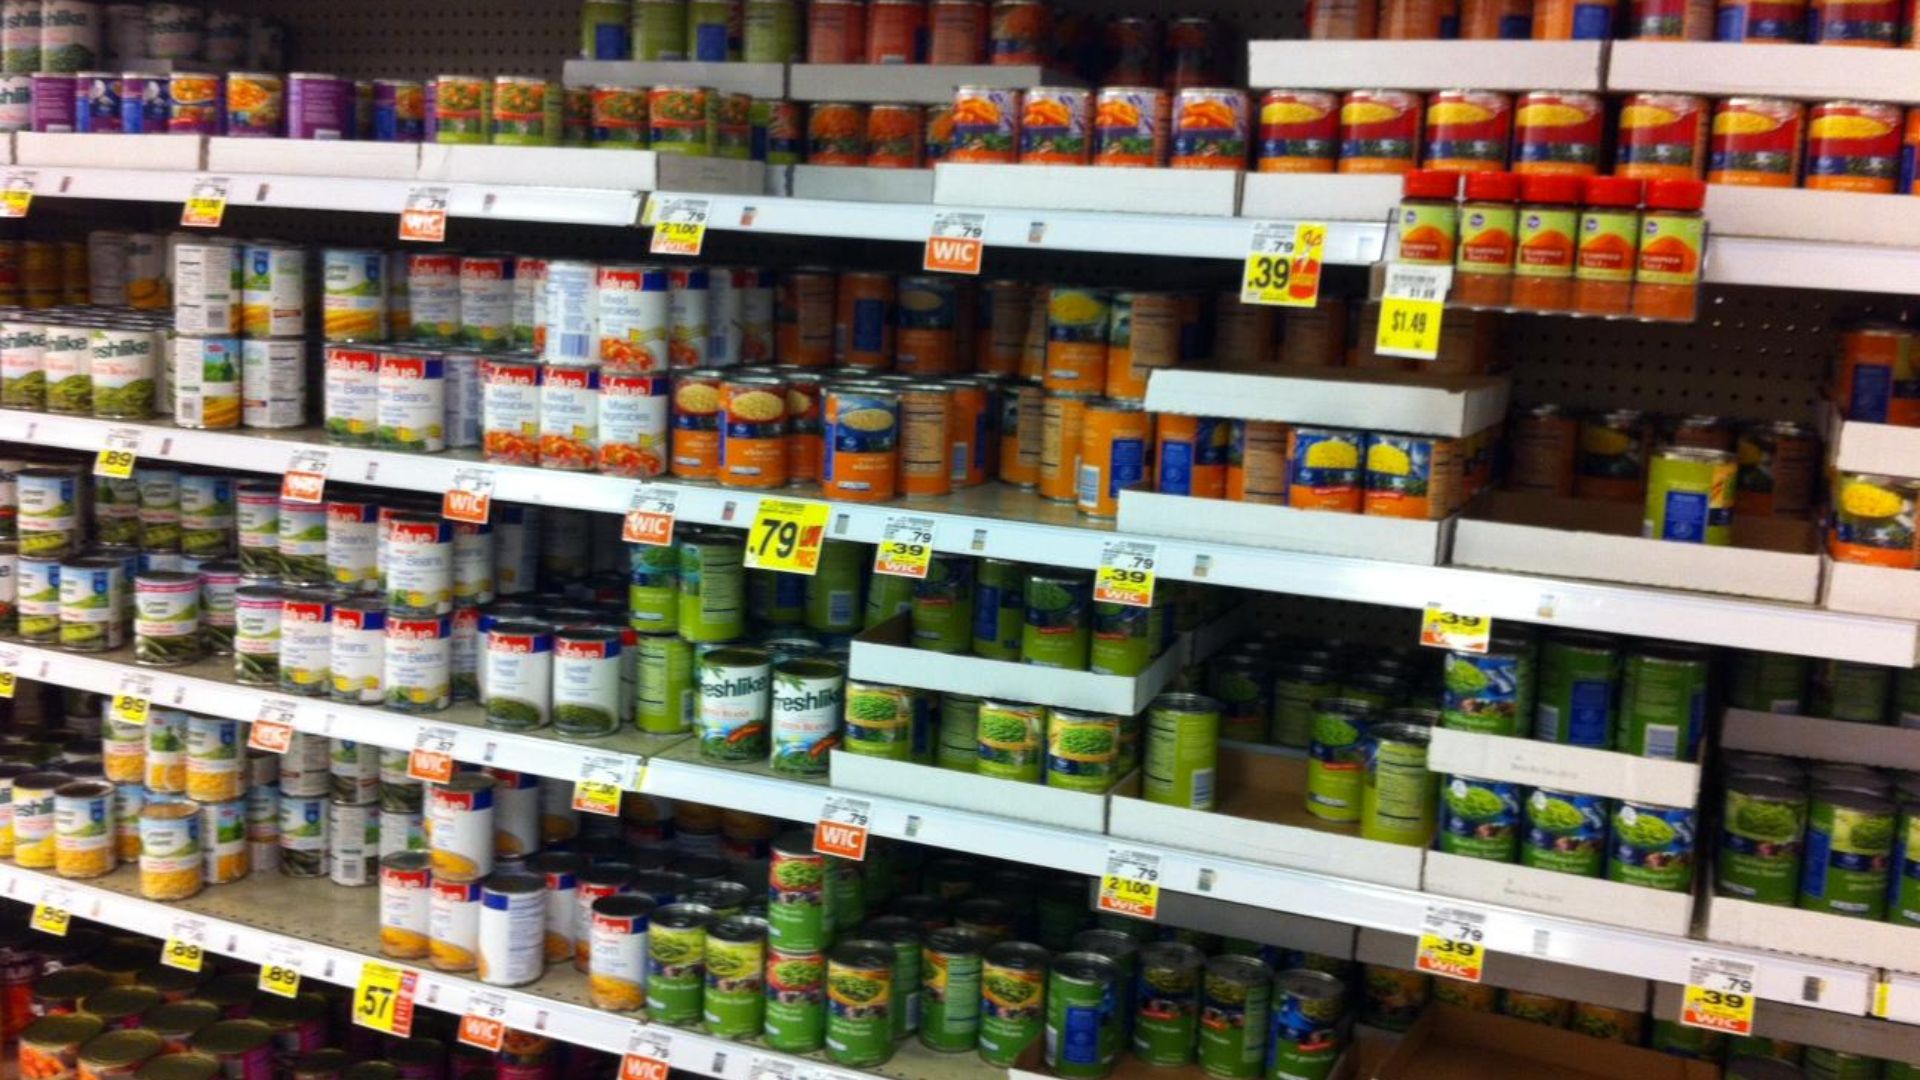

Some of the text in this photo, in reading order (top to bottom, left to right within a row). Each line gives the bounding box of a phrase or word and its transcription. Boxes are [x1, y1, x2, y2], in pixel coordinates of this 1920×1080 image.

[933, 240, 975, 262] WIC
[1247, 256, 1290, 289] .39
[1391, 310, 1428, 334] $1.49
[450, 494, 484, 513] WIC
[749, 518, 798, 559] .79
[1104, 568, 1147, 583] .39
[701, 676, 769, 697] reshlike
[820, 825, 861, 848] WIC
[358, 985, 394, 1019] .57
[1694, 990, 1745, 1008] .39
[465, 1018, 499, 1041] WIC
[626, 1056, 664, 1080] WIC
